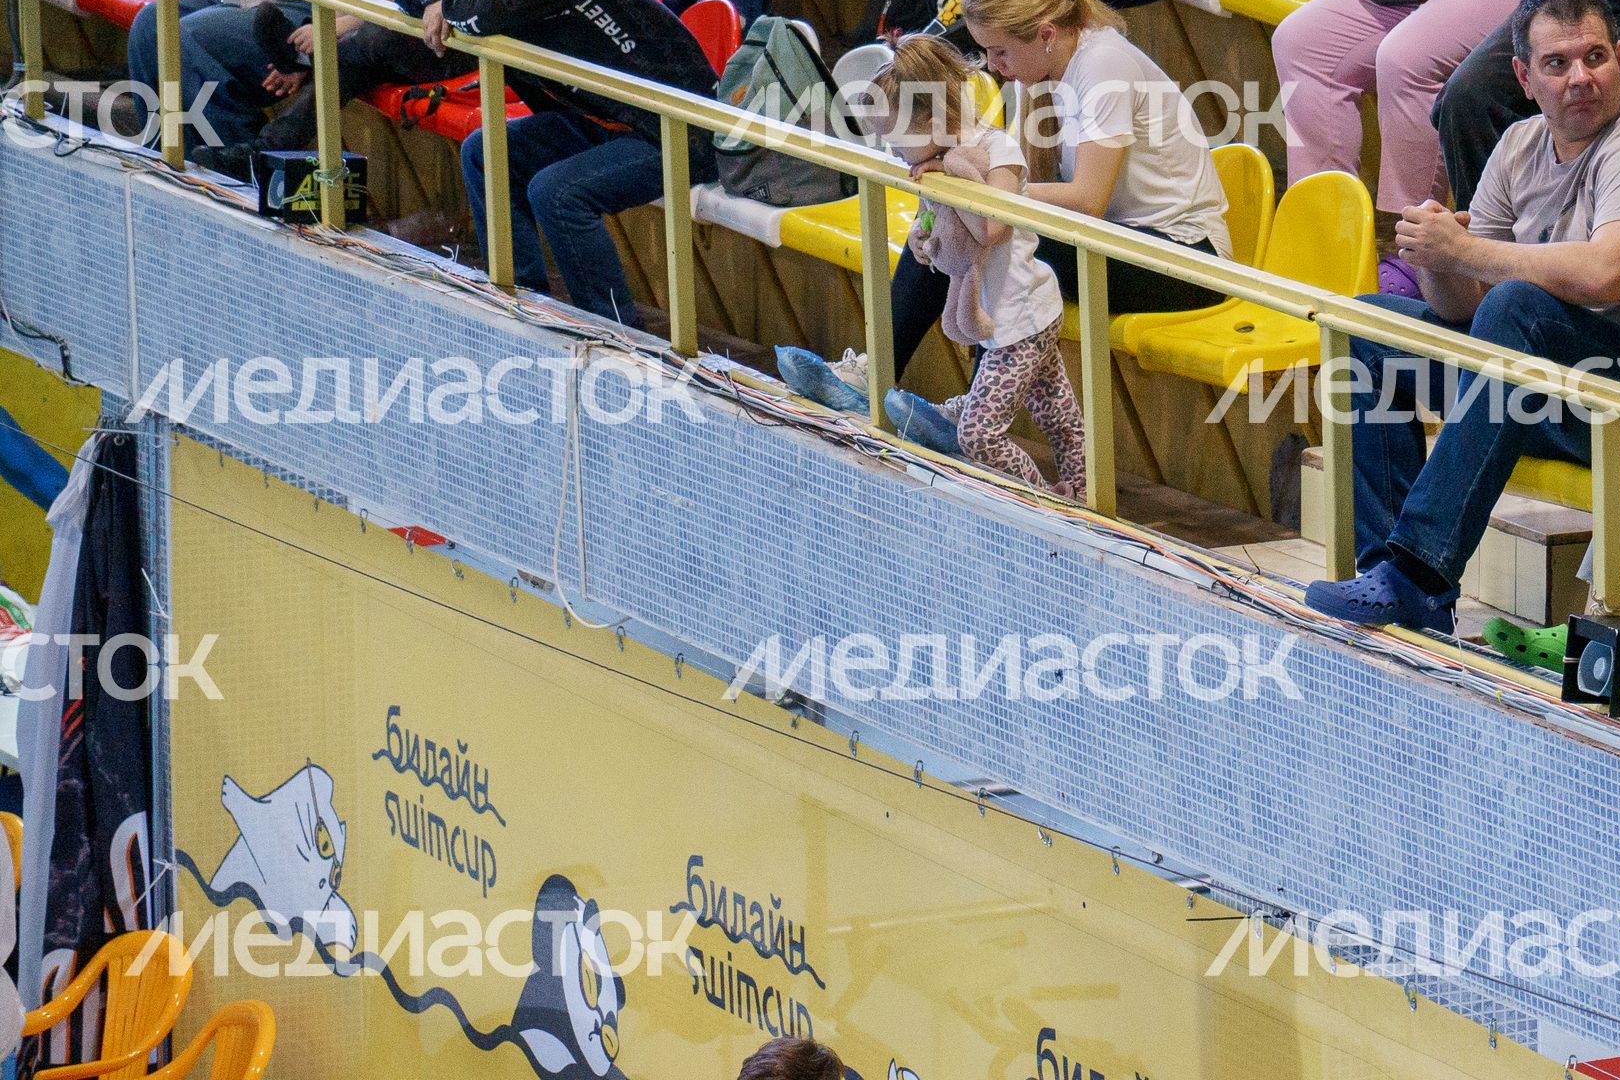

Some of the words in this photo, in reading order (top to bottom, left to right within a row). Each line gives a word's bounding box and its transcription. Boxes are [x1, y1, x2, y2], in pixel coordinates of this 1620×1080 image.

[294, 173, 360, 198] AE
[372, 705, 506, 827] билайн
[385, 790, 497, 899] swimcup
[669, 854, 826, 990] билайн
